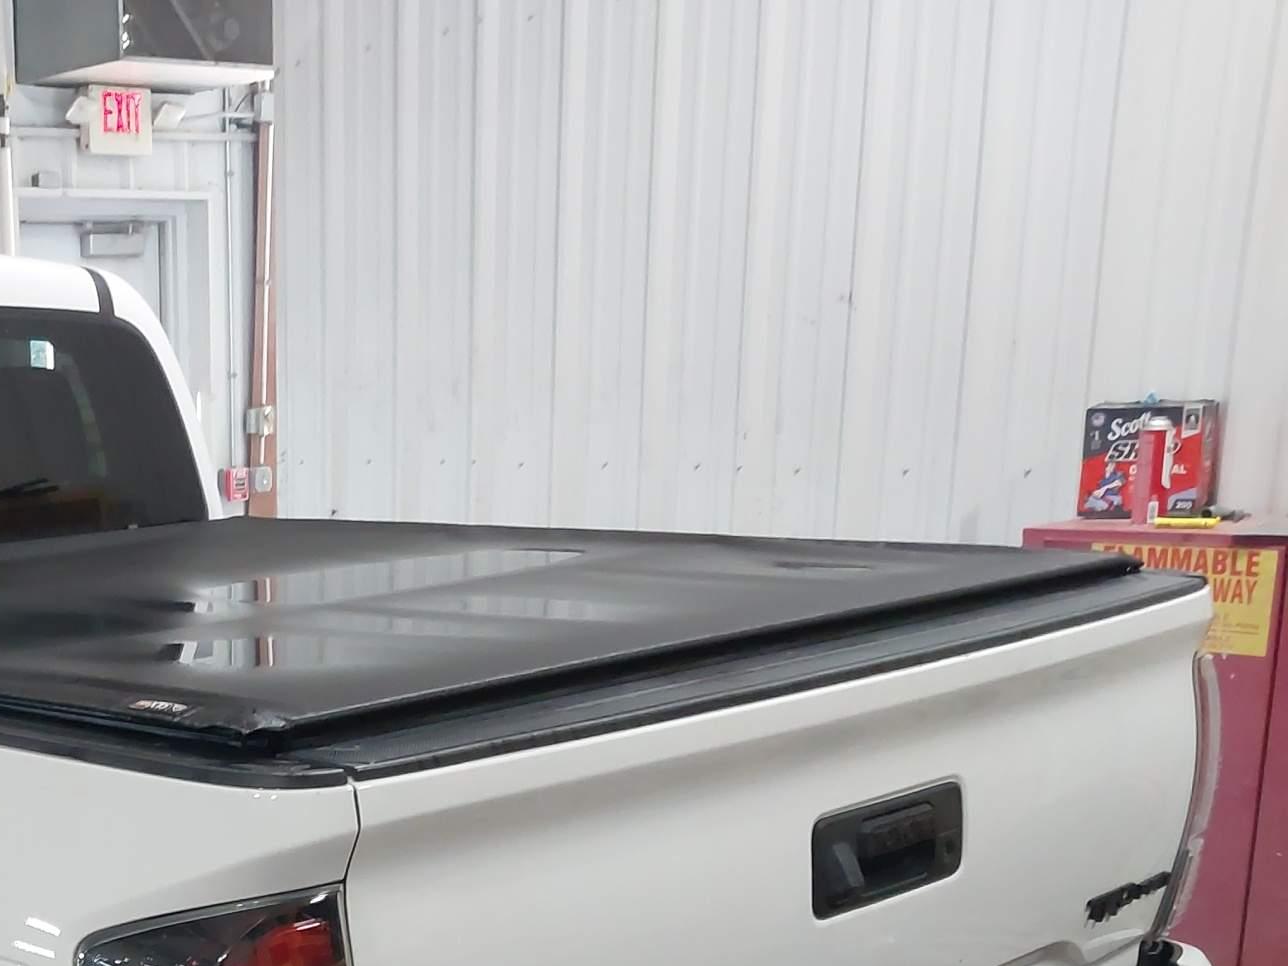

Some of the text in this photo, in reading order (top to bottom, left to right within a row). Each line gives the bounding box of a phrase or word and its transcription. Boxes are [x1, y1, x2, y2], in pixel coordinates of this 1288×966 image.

[101, 91, 142, 135] EXIT
[1103, 545, 1261, 578] AMMABLE
[1213, 578, 1258, 605] WAY
